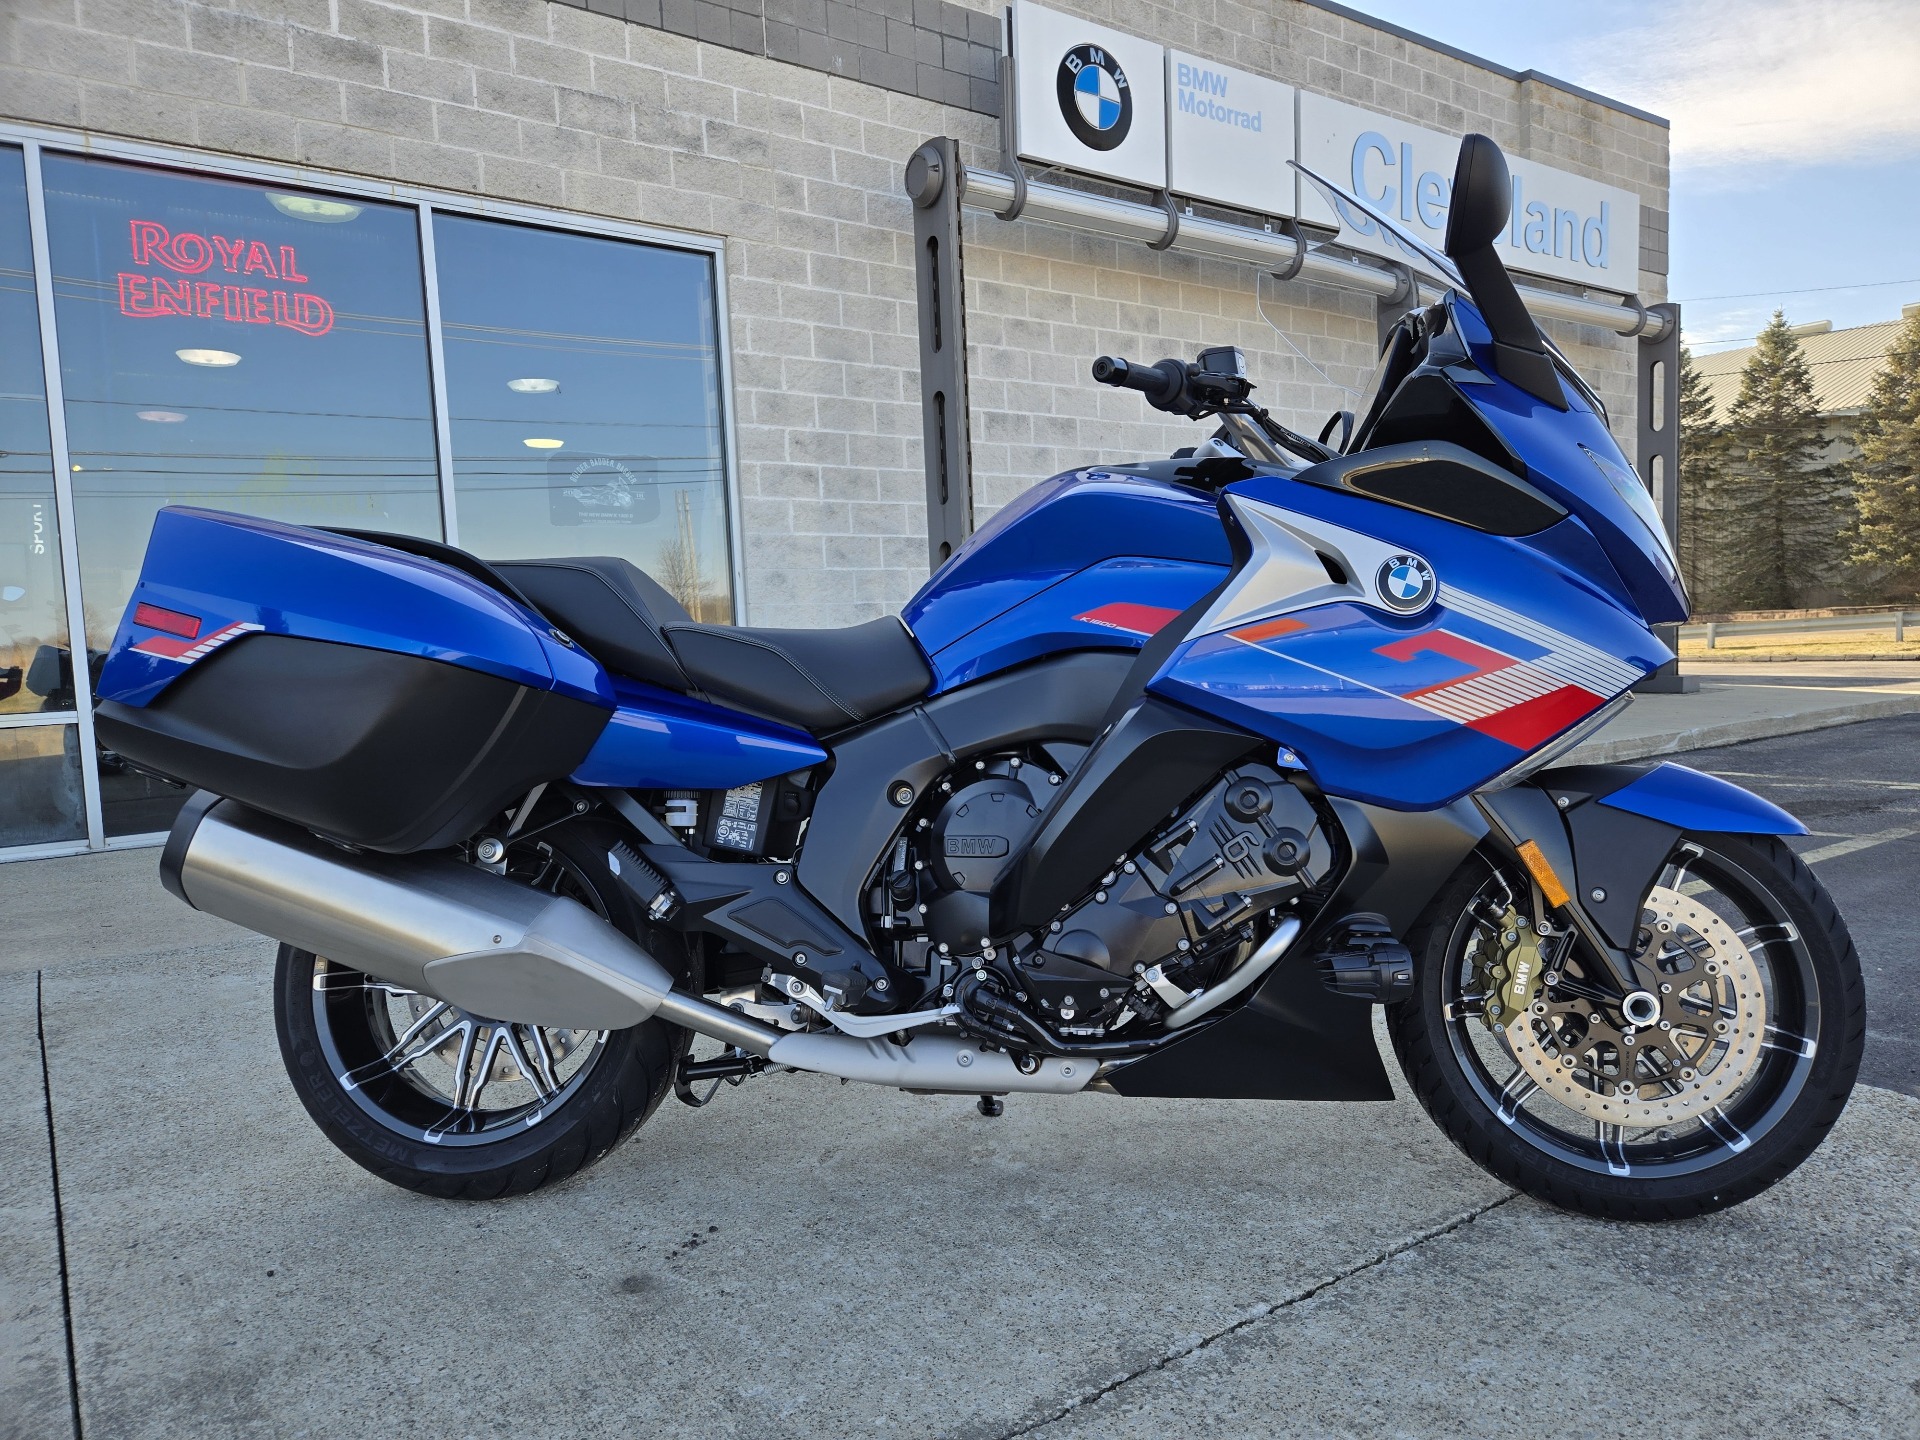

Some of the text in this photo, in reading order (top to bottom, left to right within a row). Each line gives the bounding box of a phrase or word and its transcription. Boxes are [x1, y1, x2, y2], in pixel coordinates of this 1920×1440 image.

[1065, 47, 1128, 89] BMW
[1177, 62, 1228, 98] BMW
[1178, 88, 1262, 132] Motorrad
[1351, 131, 1610, 269] Cleland
[129, 220, 308, 284] ROYAL
[118, 272, 334, 337] ENFIELD
[1388, 557, 1431, 581] BMW
[946, 838, 996, 854] BMW
[1513, 960, 1530, 995] BMW
